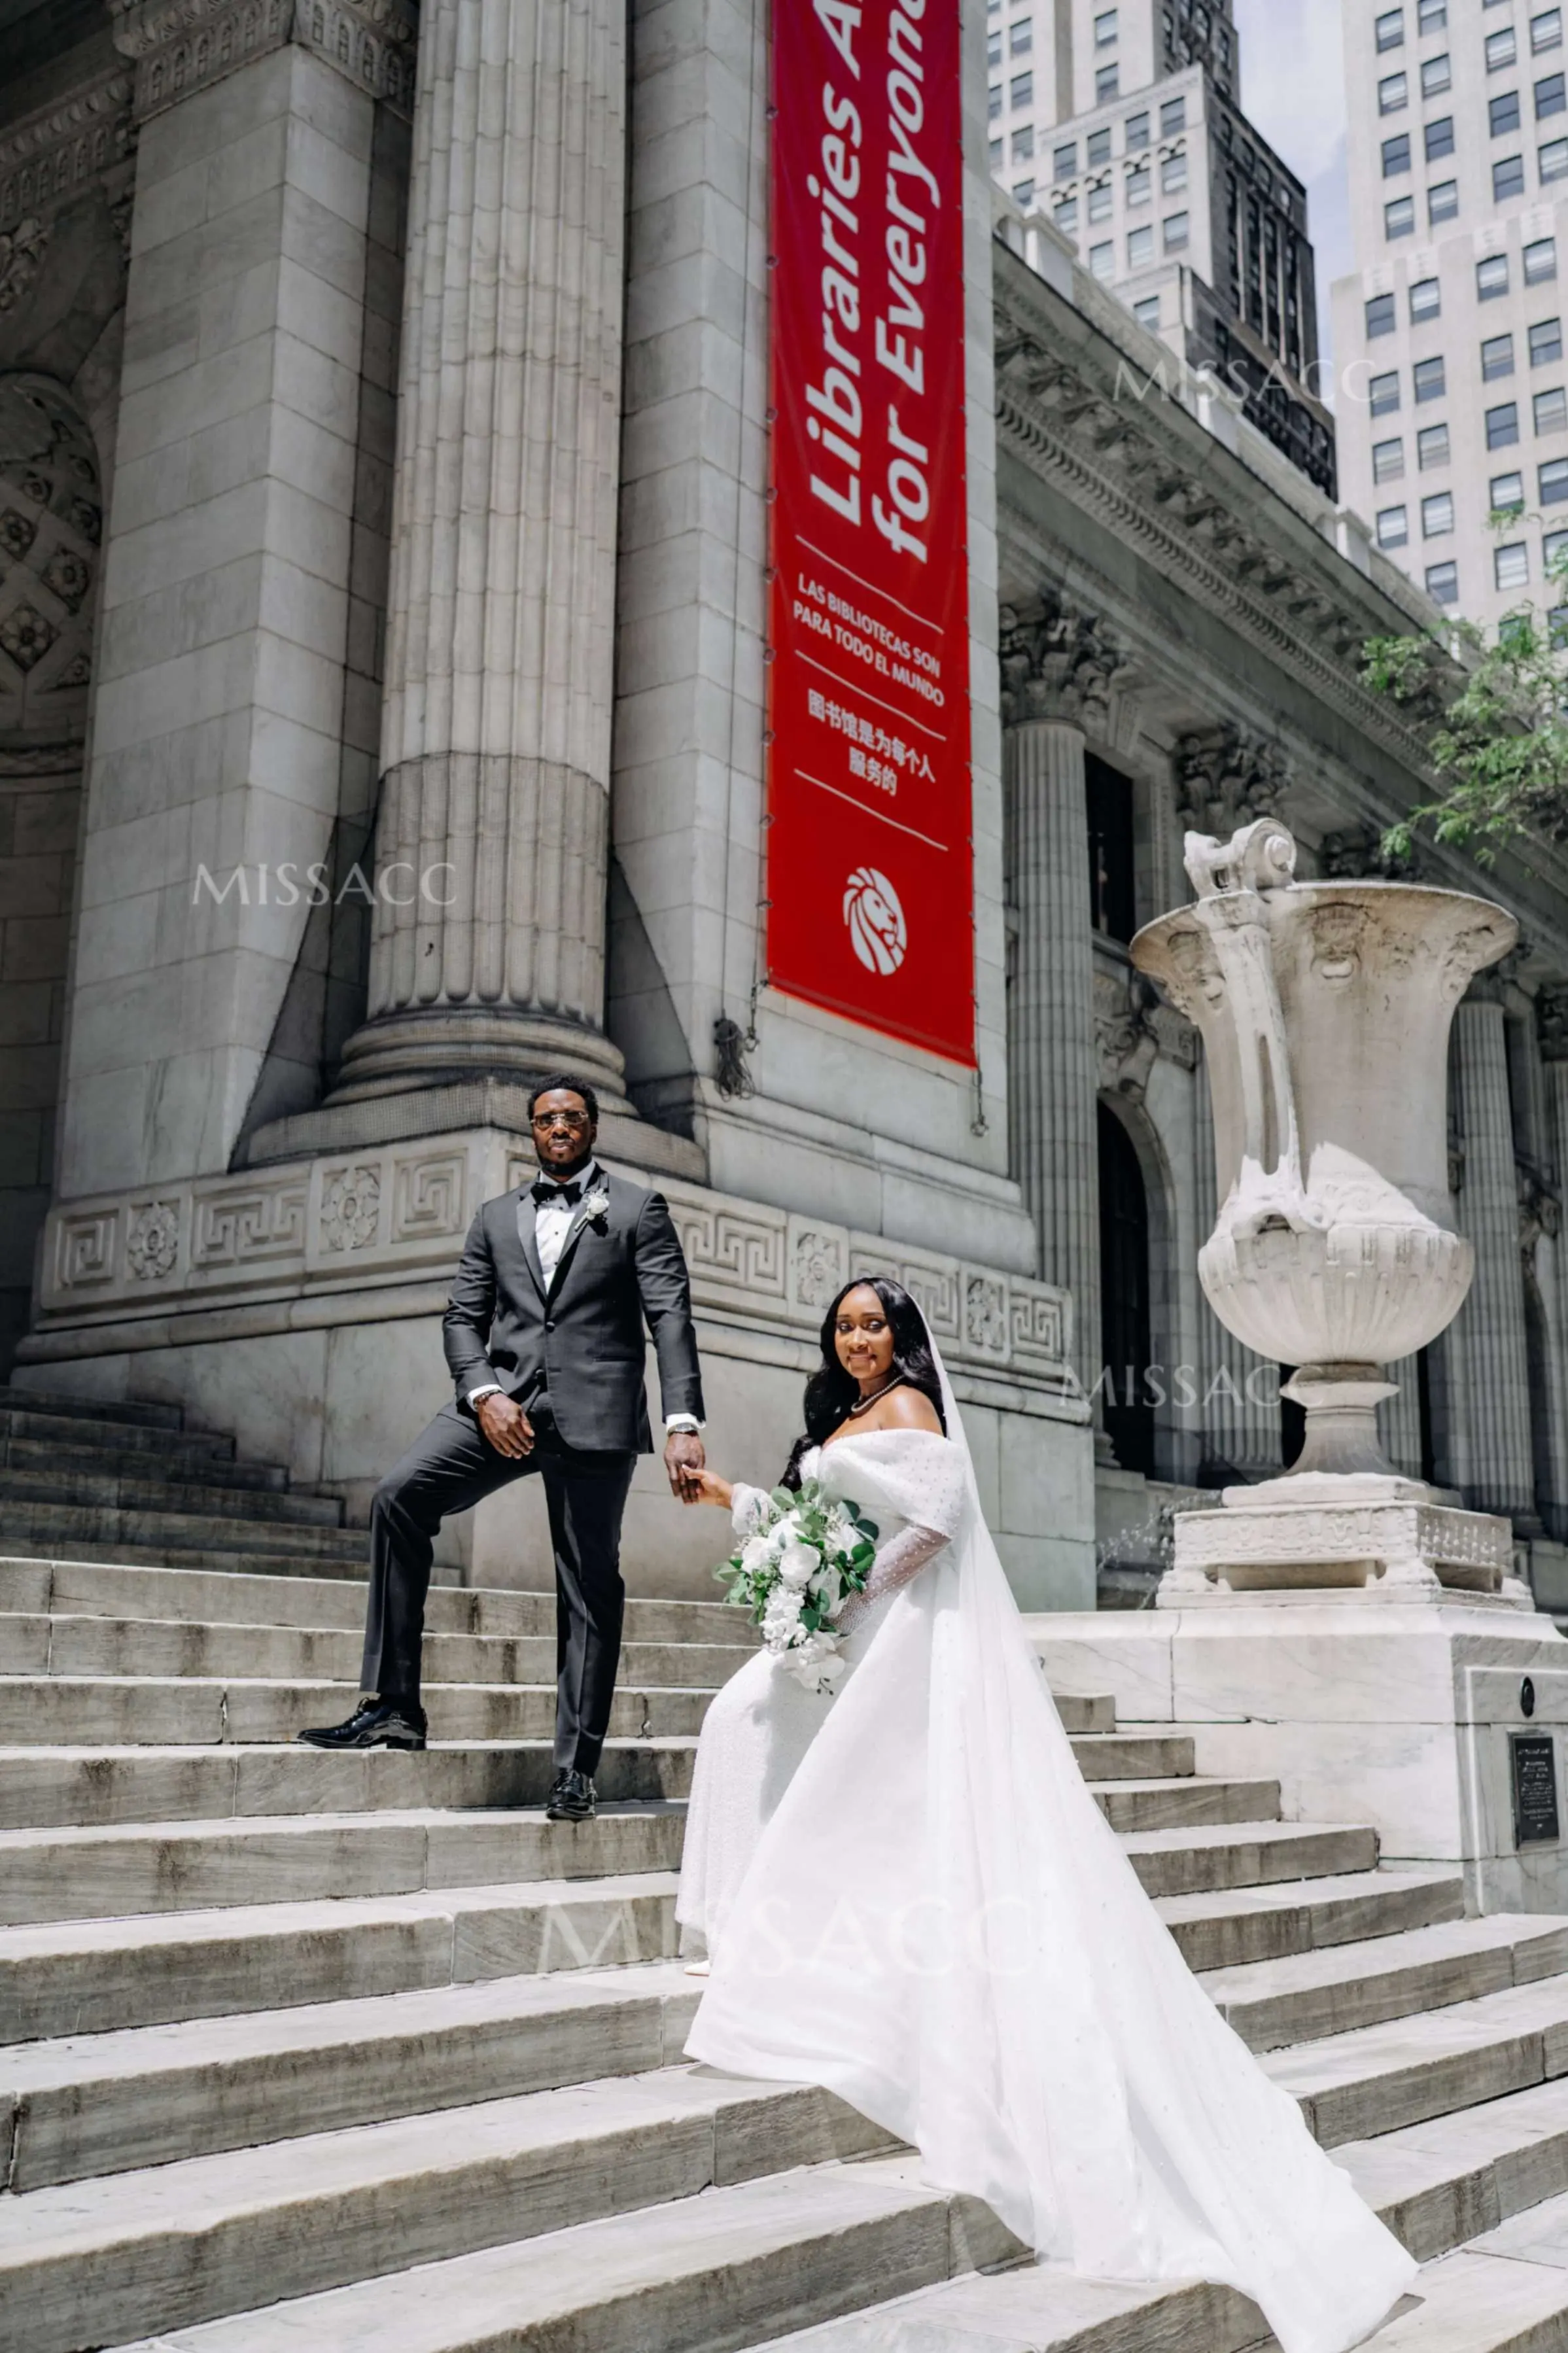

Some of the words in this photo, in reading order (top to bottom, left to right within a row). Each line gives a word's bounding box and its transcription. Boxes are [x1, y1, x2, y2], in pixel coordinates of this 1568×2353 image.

[812, 0, 863, 81] A
[806, 82, 862, 525] Libraries
[871, 404, 930, 564] for
[793, 599, 832, 639] PARA
[834, 623, 874, 664] TODO
[875, 650, 890, 676] EL
[892, 662, 945, 706] MUNDO
[798, 572, 826, 604] LAS
[828, 591, 911, 659] BIBLIOTECAS
[913, 646, 941, 678] SON
[808, 688, 936, 784] 图书馆是为每个人
[849, 745, 897, 797] 服务的
